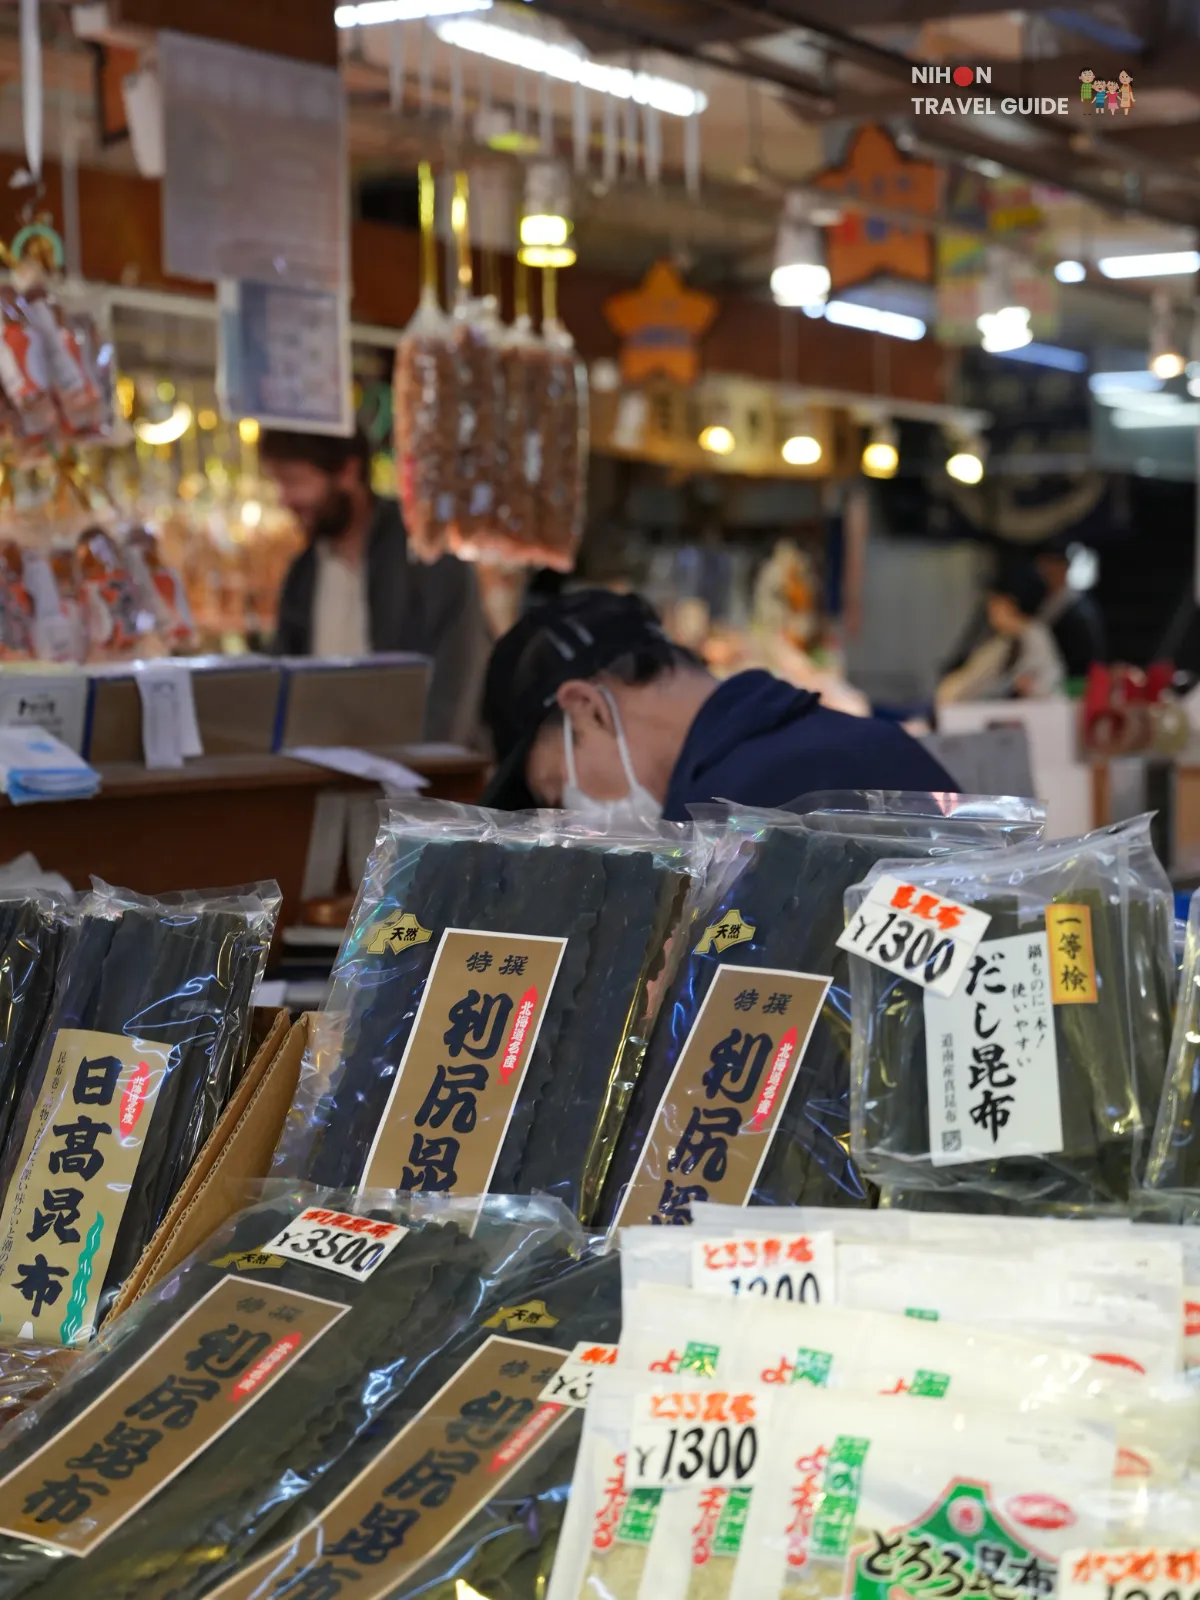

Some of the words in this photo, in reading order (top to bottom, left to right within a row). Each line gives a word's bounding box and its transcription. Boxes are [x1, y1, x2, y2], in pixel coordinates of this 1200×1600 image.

[390, 927, 419, 941] 天然
[466, 951, 529, 976] 特撰
[715, 923, 743, 939] 天然
[1055, 916, 1088, 992] 一等検
[503, 1001, 534, 1069] 北海道名産
[733, 988, 793, 1016] 特撰
[1012, 982, 1032, 1067] 使いやすい
[757, 1043, 793, 1114] 北海道名産
[965, 952, 1017, 1144] だし昆布
[122, 1076, 145, 1125] 北海道名産
[12, 1056, 122, 1317] 日高昆布
[23, 1323, 272, 1523] 利尻昆布
[865, 1530, 1058, 1600] とろろ昆布
